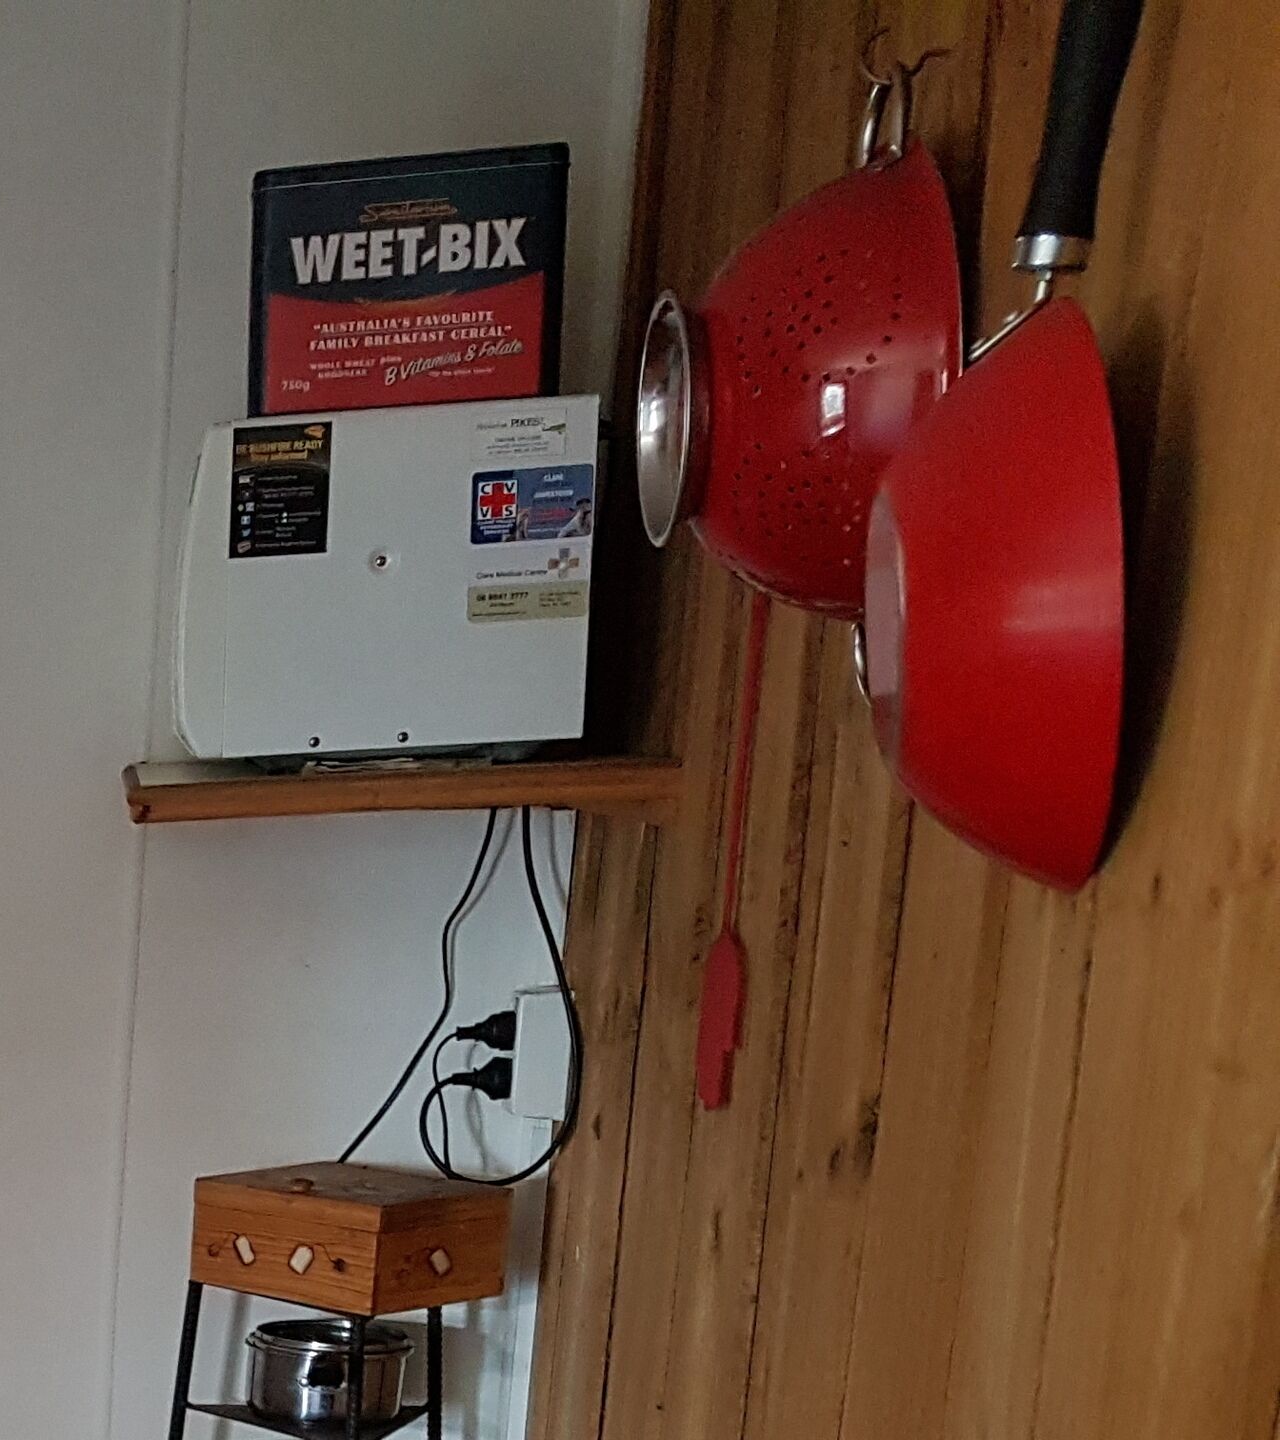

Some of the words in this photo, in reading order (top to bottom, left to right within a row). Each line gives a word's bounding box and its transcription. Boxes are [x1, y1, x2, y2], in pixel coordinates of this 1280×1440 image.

[290, 217, 527, 284] WEET-BIX
[416, 311, 494, 328] FAVOURITE
[309, 337, 359, 351] FAMILY
[364, 328, 446, 348] BREAKFAST
[384, 366, 399, 387] B
[401, 351, 462, 381] Vitamins
[465, 343, 475, 361] &
[478, 338, 523, 358] Folate
[480, 484, 490, 495] C
[505, 482, 515, 493] V
[480, 508, 490, 518] V
[505, 505, 513, 517] S
